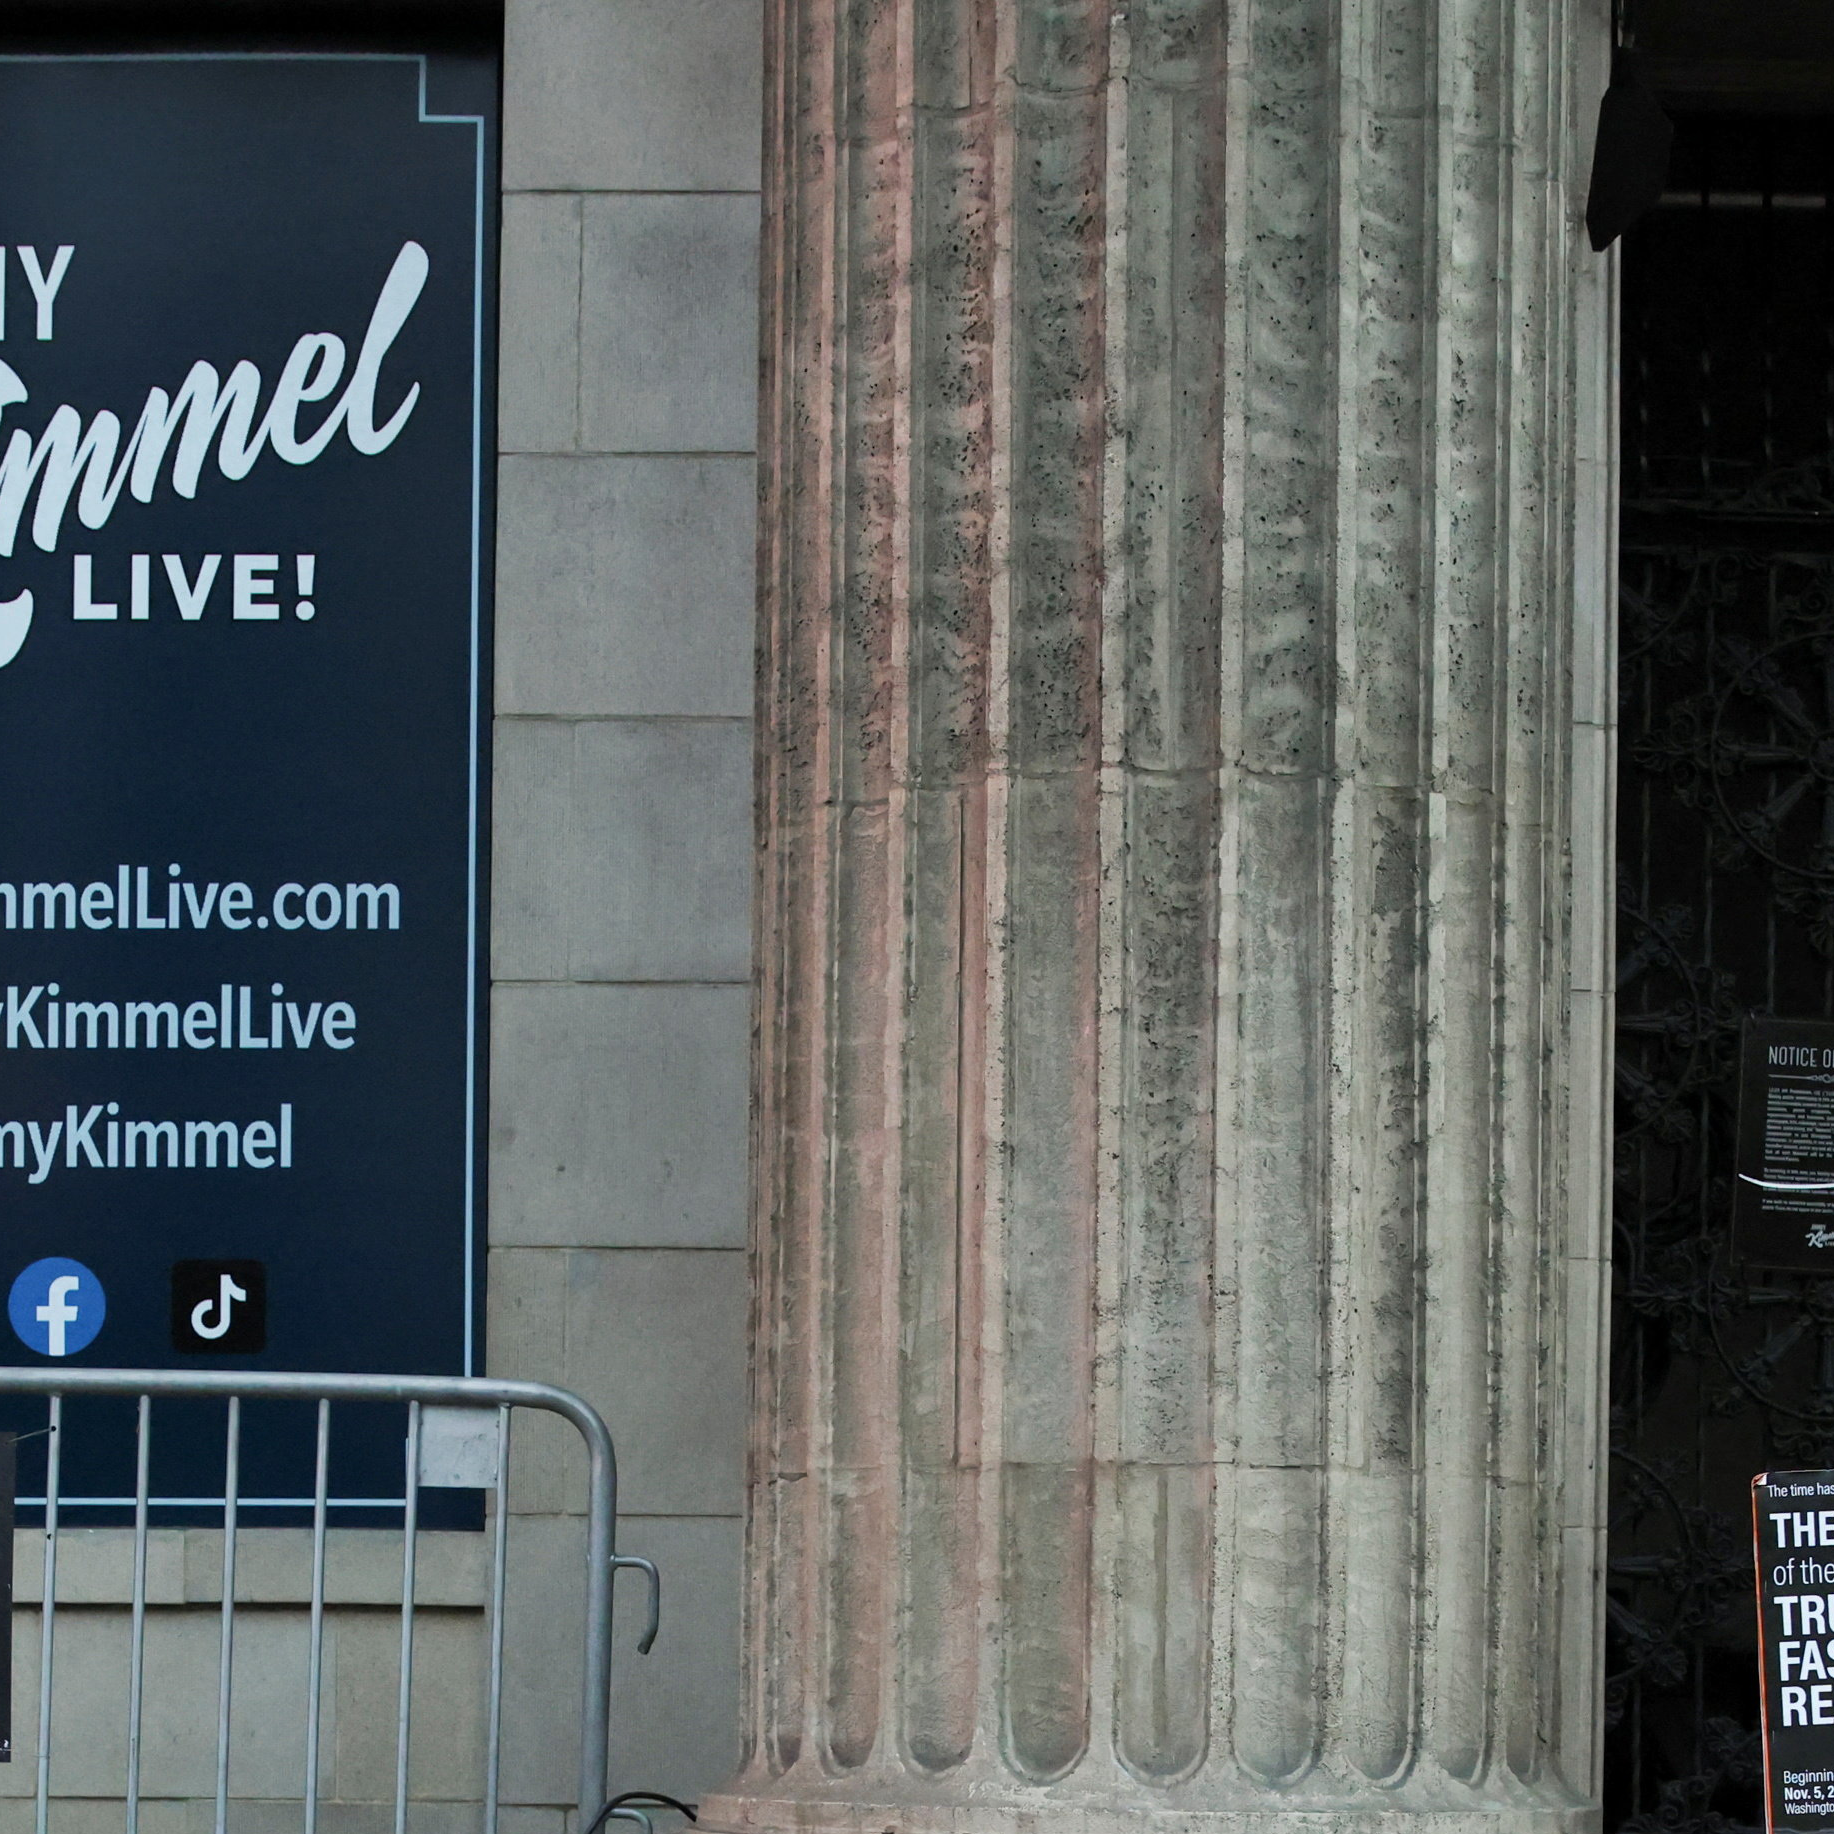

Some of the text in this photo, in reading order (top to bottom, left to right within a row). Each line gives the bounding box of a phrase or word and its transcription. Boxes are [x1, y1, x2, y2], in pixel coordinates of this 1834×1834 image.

[74, 555, 315, 620] LIVE!
[1768, 1046, 1817, 1068] NOTICE
[1766, 1485, 1787, 1497] The
[1790, 1485, 1814, 1496] time
[1774, 1558, 1794, 1585] of
[1785, 1787, 1811, 1800] Nov.
[1814, 1786, 1824, 1800] 5,
